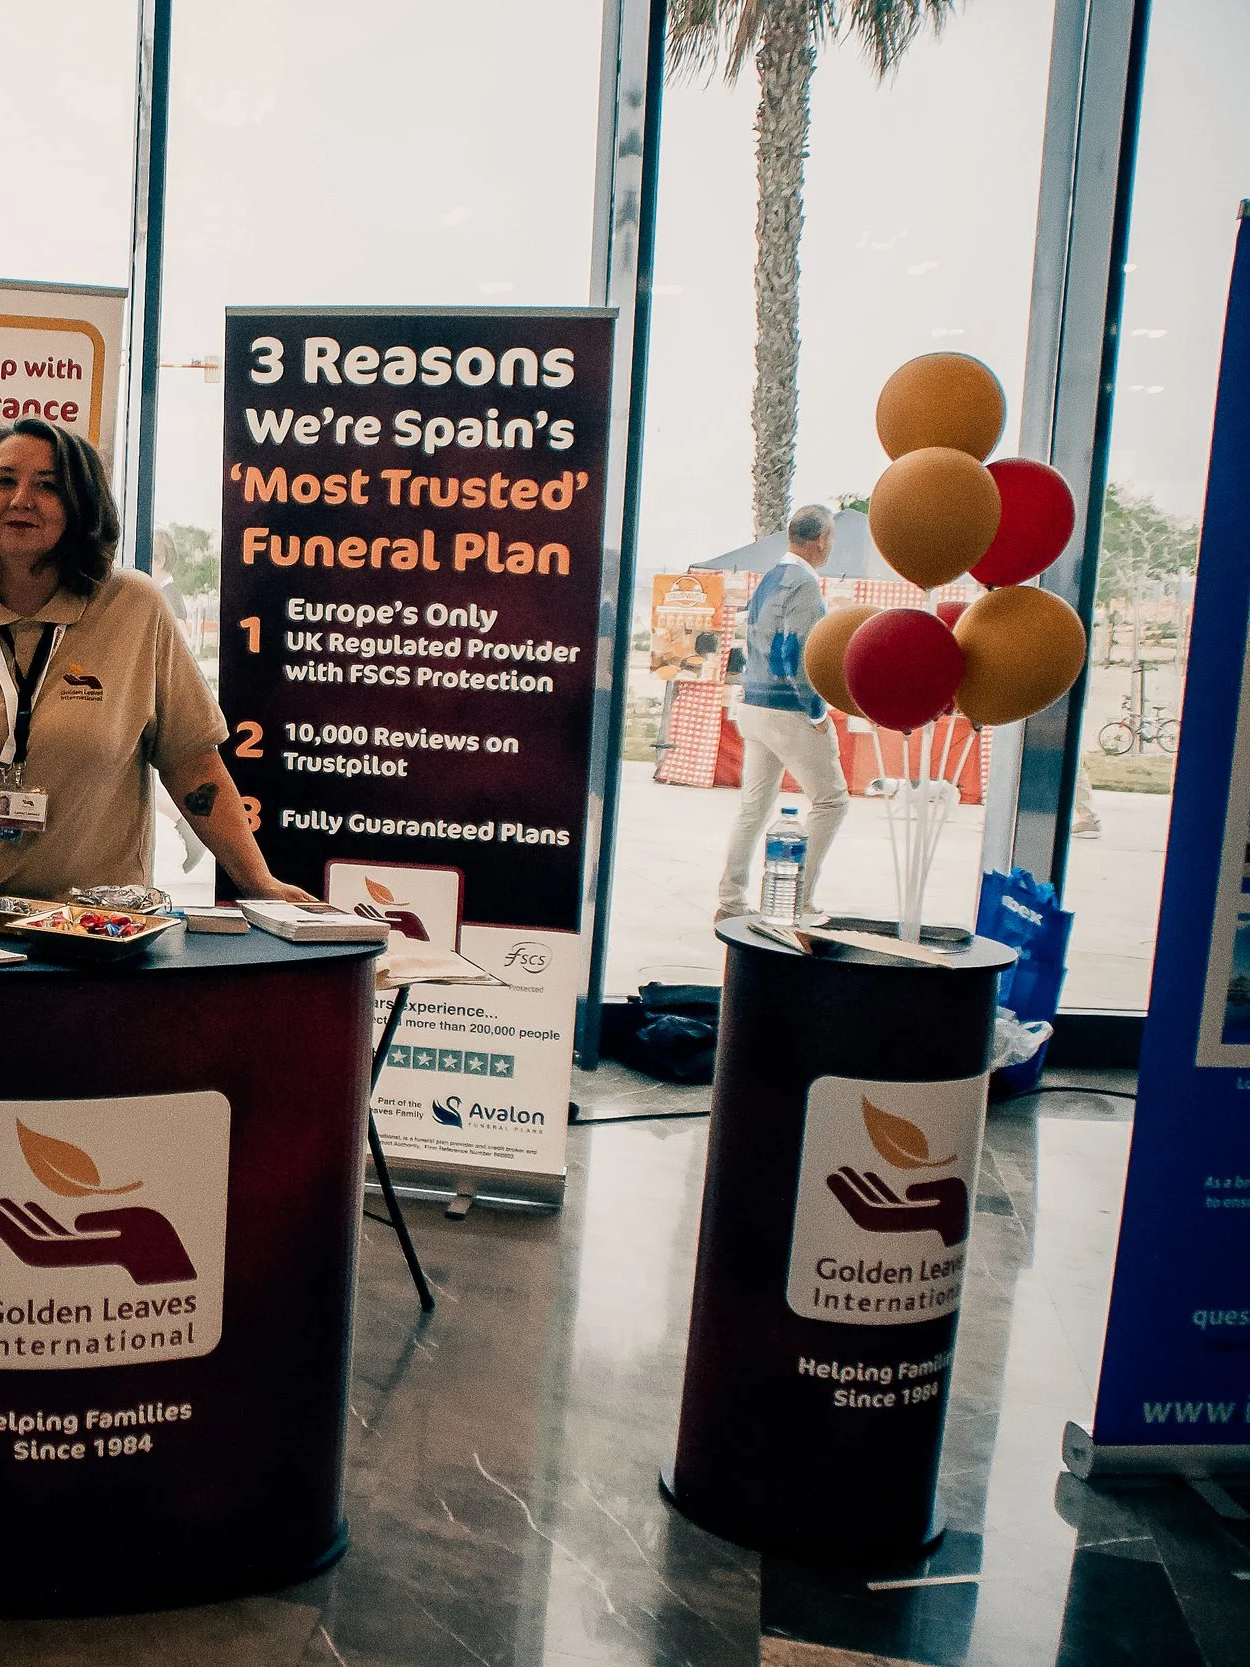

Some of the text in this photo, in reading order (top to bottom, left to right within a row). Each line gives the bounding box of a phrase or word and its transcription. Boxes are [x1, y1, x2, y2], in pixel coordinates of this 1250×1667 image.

[24, 357, 82, 380] with
[250, 336, 575, 388] 3 Reasons
[245, 406, 575, 455] We’re Spain’s
[243, 527, 570, 576] Funeral Plan
[287, 597, 498, 633] Europe’s Only
[239, 616, 261, 653] 1
[287, 632, 580, 663] UK Regulated Provider
[285, 660, 554, 693] with FSCS Protection
[235, 721, 264, 758] 2
[284, 723, 519, 754] 10,000 Reviews on
[283, 751, 408, 778] Trustpilot
[281, 809, 570, 847] Fully Guaranteed Plans
[509, 984, 544, 993] Protected
[373, 998, 393, 1010] ars
[406, 1019, 436, 1029] more
[440, 1021, 466, 1032] than
[469, 1023, 515, 1037] 200,000
[519, 1029, 561, 1041] people
[370, 1108, 424, 1120] eaves Family
[378, 1097, 422, 1109] Part of the
[469, 1103, 545, 1126] Avalon
[468, 1122, 509, 1131] FUNERAL
[816, 1257, 912, 1285] Golden
[103, 1294, 197, 1321] Leaves
[798, 1356, 892, 1385] Helping
[833, 1389, 895, 1408] Since
[86, 1403, 193, 1430] Families
[13, 1434, 154, 1461] Since 1984
